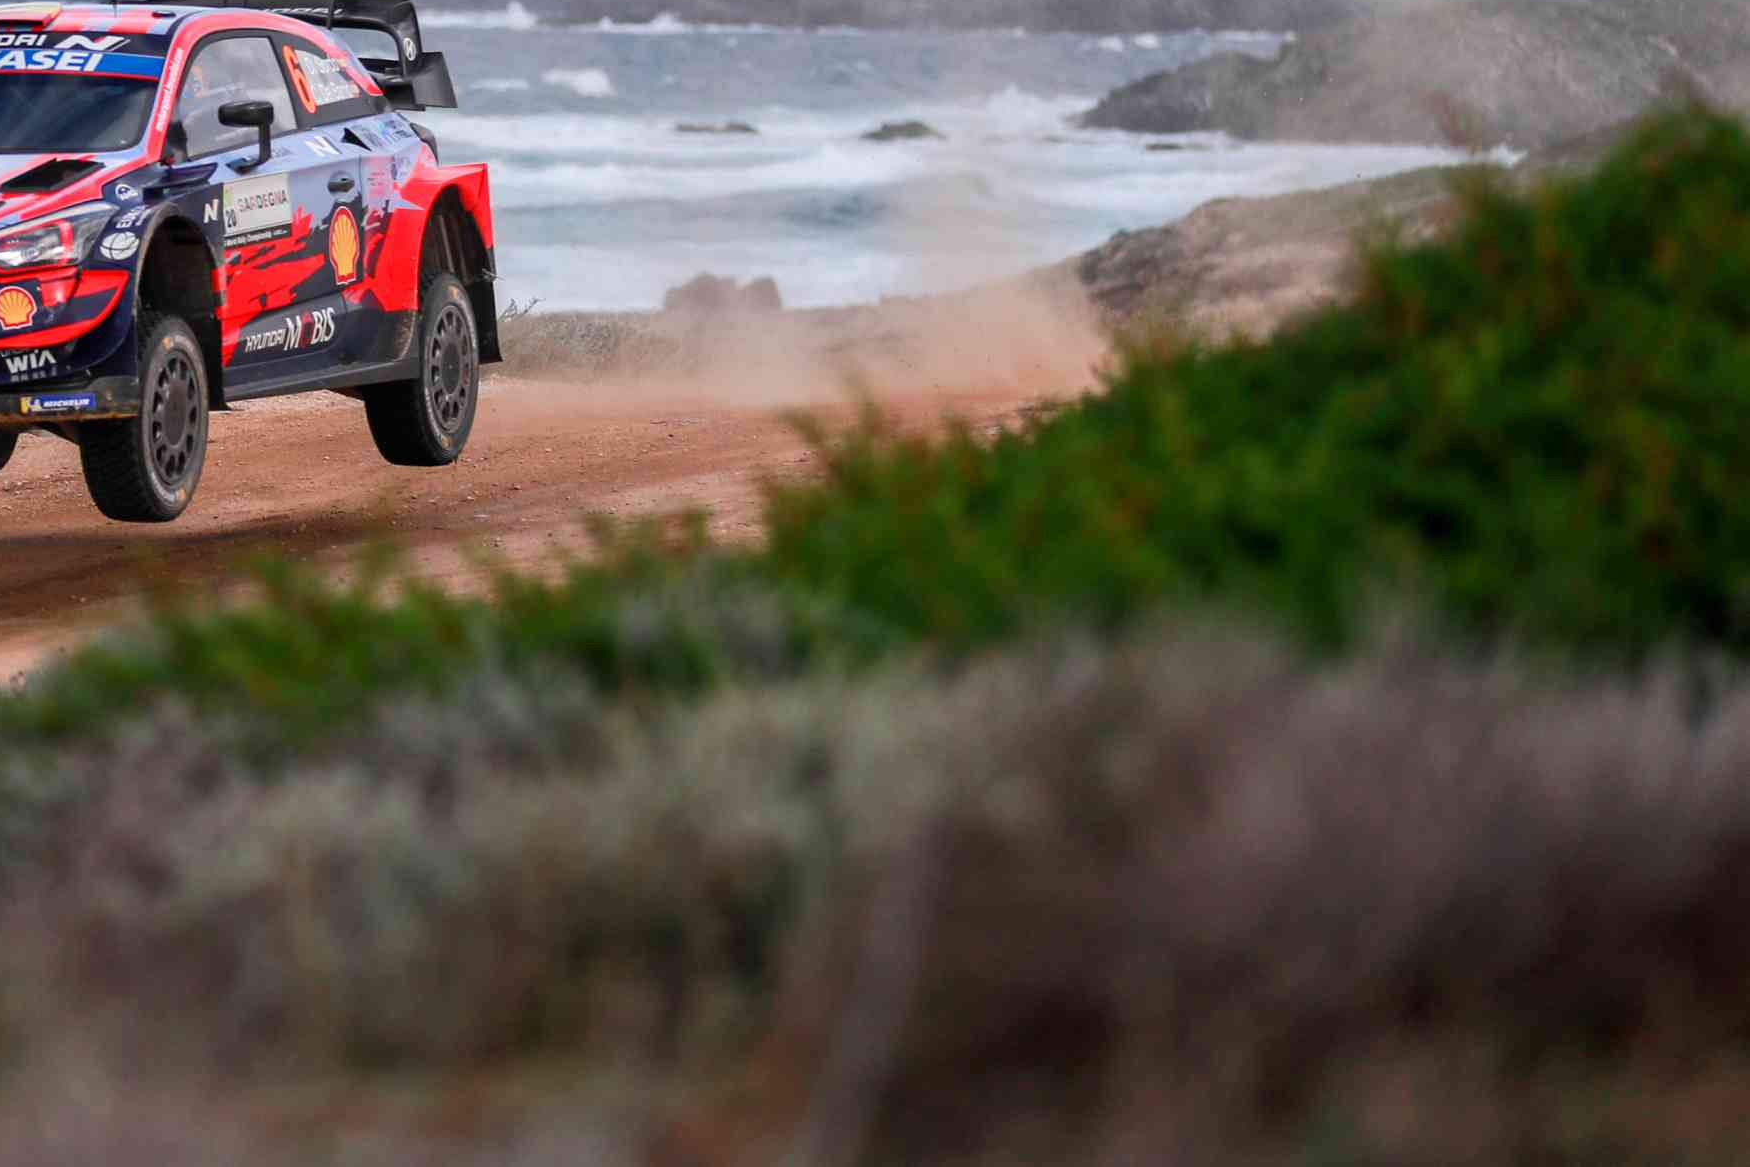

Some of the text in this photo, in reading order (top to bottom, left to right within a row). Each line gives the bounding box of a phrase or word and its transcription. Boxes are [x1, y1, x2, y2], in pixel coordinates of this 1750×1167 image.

[282, 44, 318, 114] 6
[203, 199, 220, 224] N
[236, 190, 288, 212] SARDEGNA
[244, 307, 337, 353] HYUNDAI MOBIS
